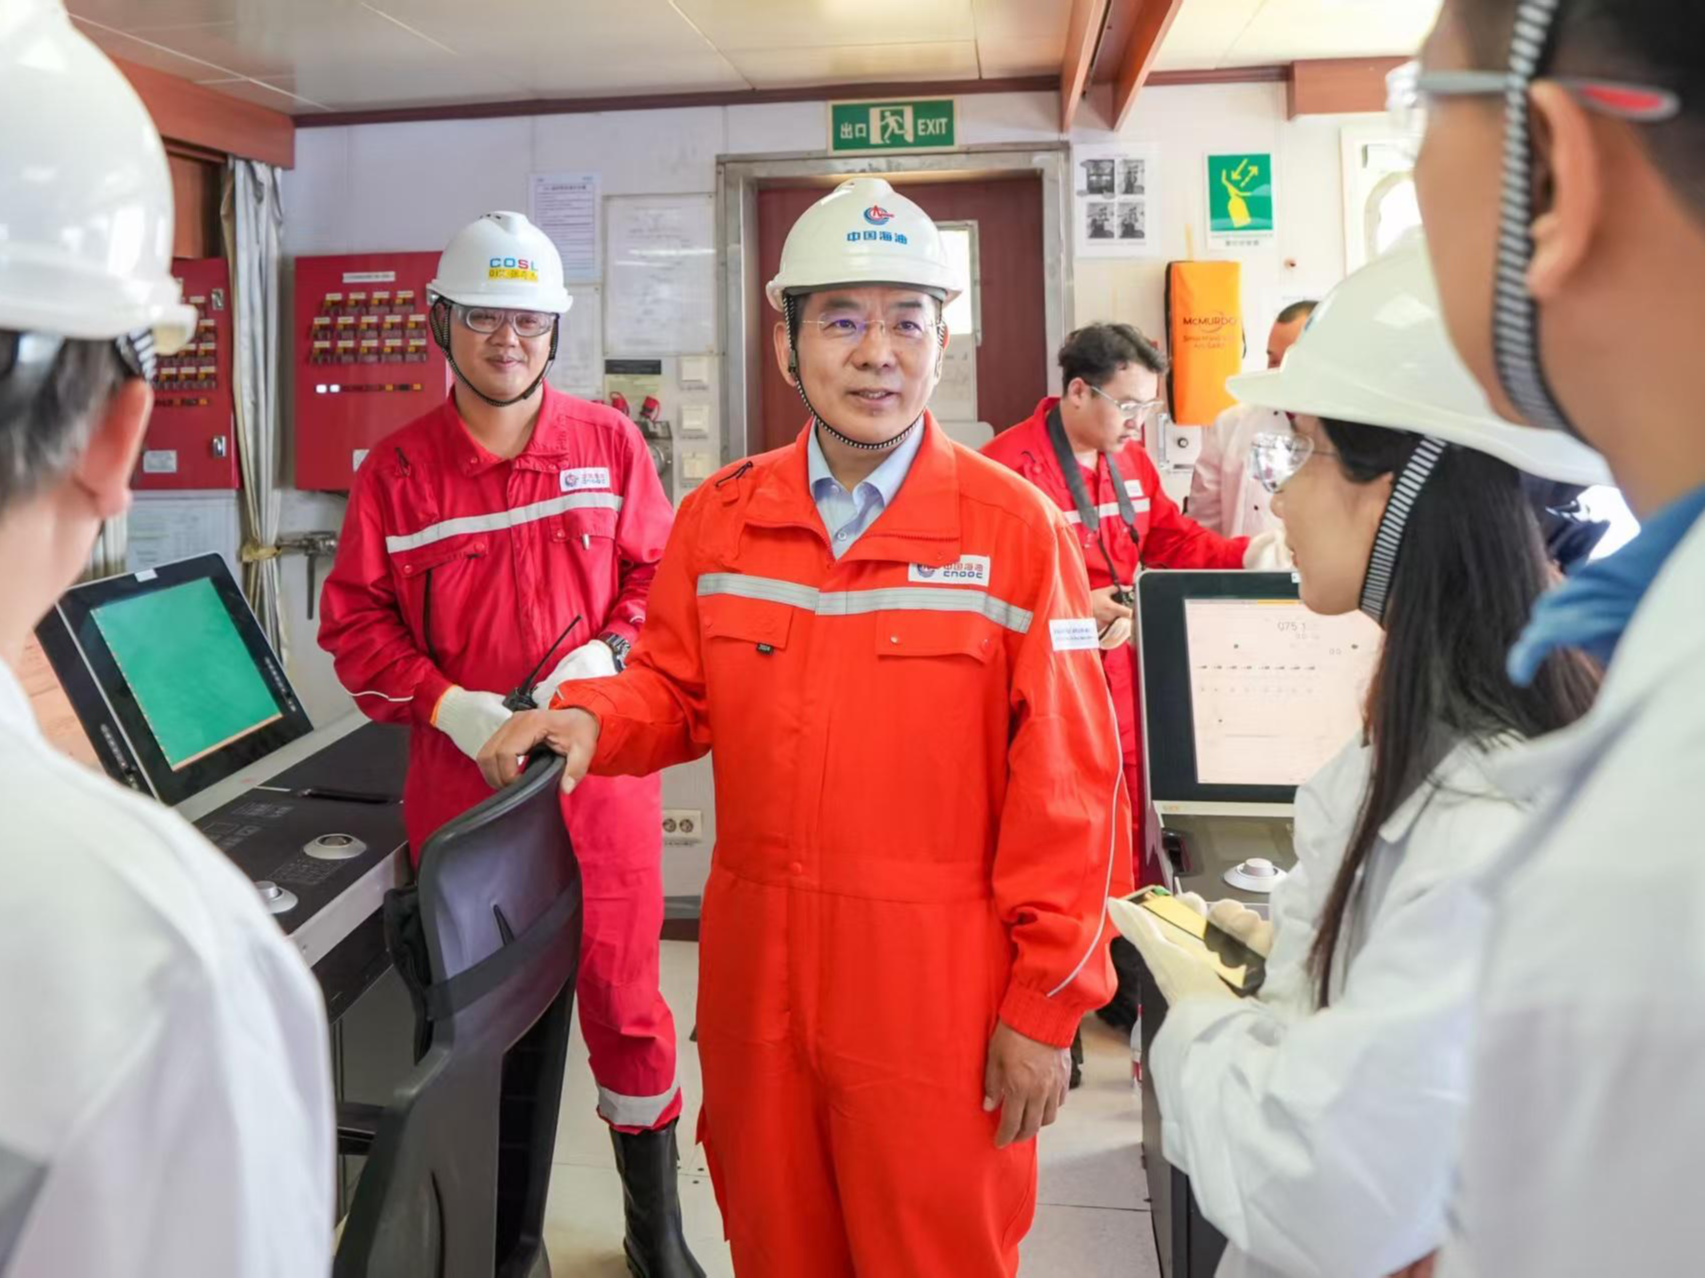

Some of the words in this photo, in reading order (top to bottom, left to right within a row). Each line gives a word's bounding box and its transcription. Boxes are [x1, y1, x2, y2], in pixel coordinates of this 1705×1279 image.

[840, 121, 867, 139] 出口
[917, 117, 948, 136] EXIT
[847, 230, 908, 245] 中国海油
[489, 257, 538, 271] COSL
